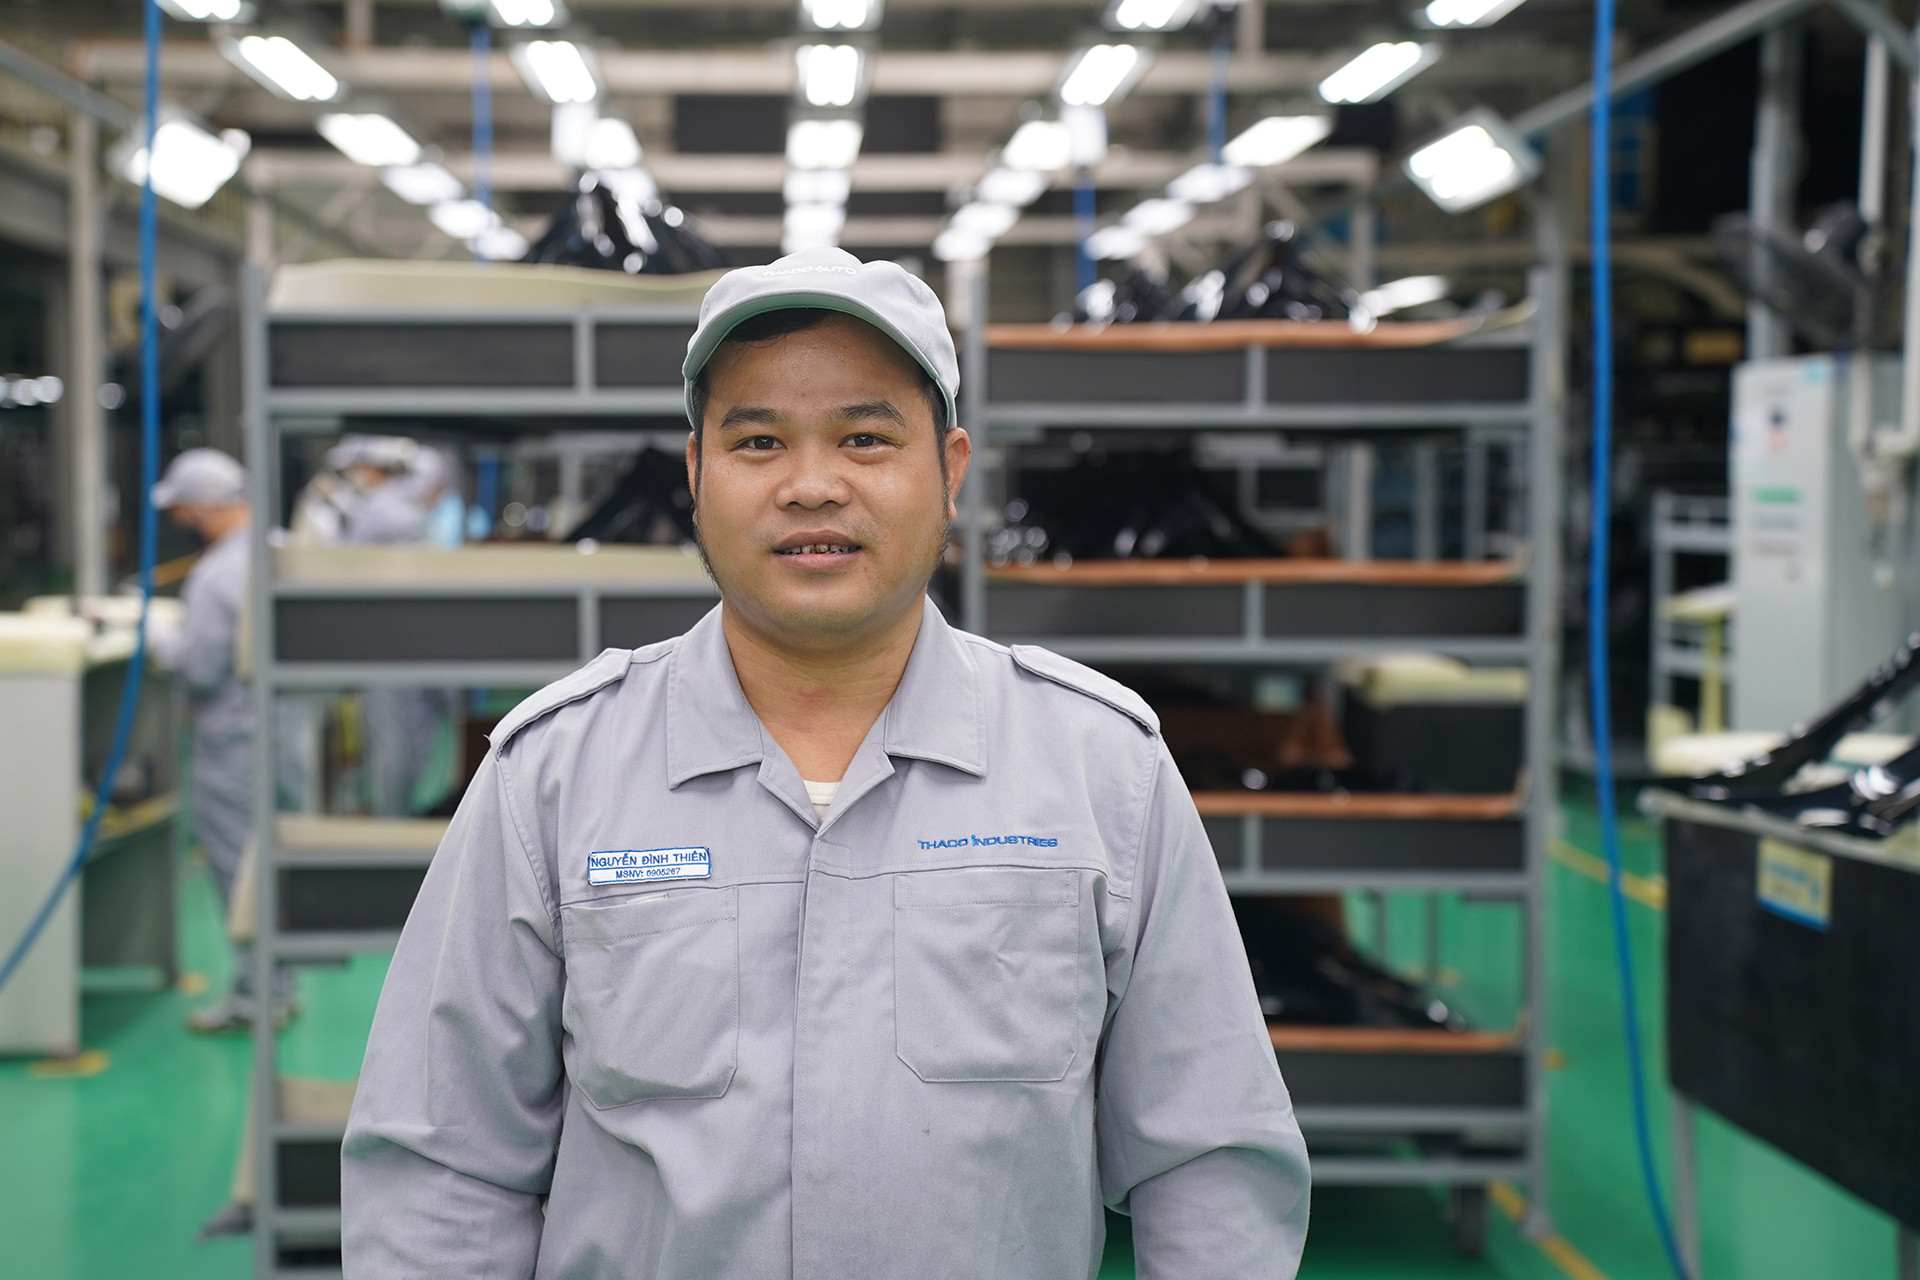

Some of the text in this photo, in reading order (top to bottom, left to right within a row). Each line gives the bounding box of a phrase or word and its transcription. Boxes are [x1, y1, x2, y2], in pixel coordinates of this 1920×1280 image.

[815, 264, 857, 275] AUTO
[917, 838, 968, 850] THACO
[642, 853, 669, 865] ĐÌNH
[615, 870, 644, 879] MSNV:
